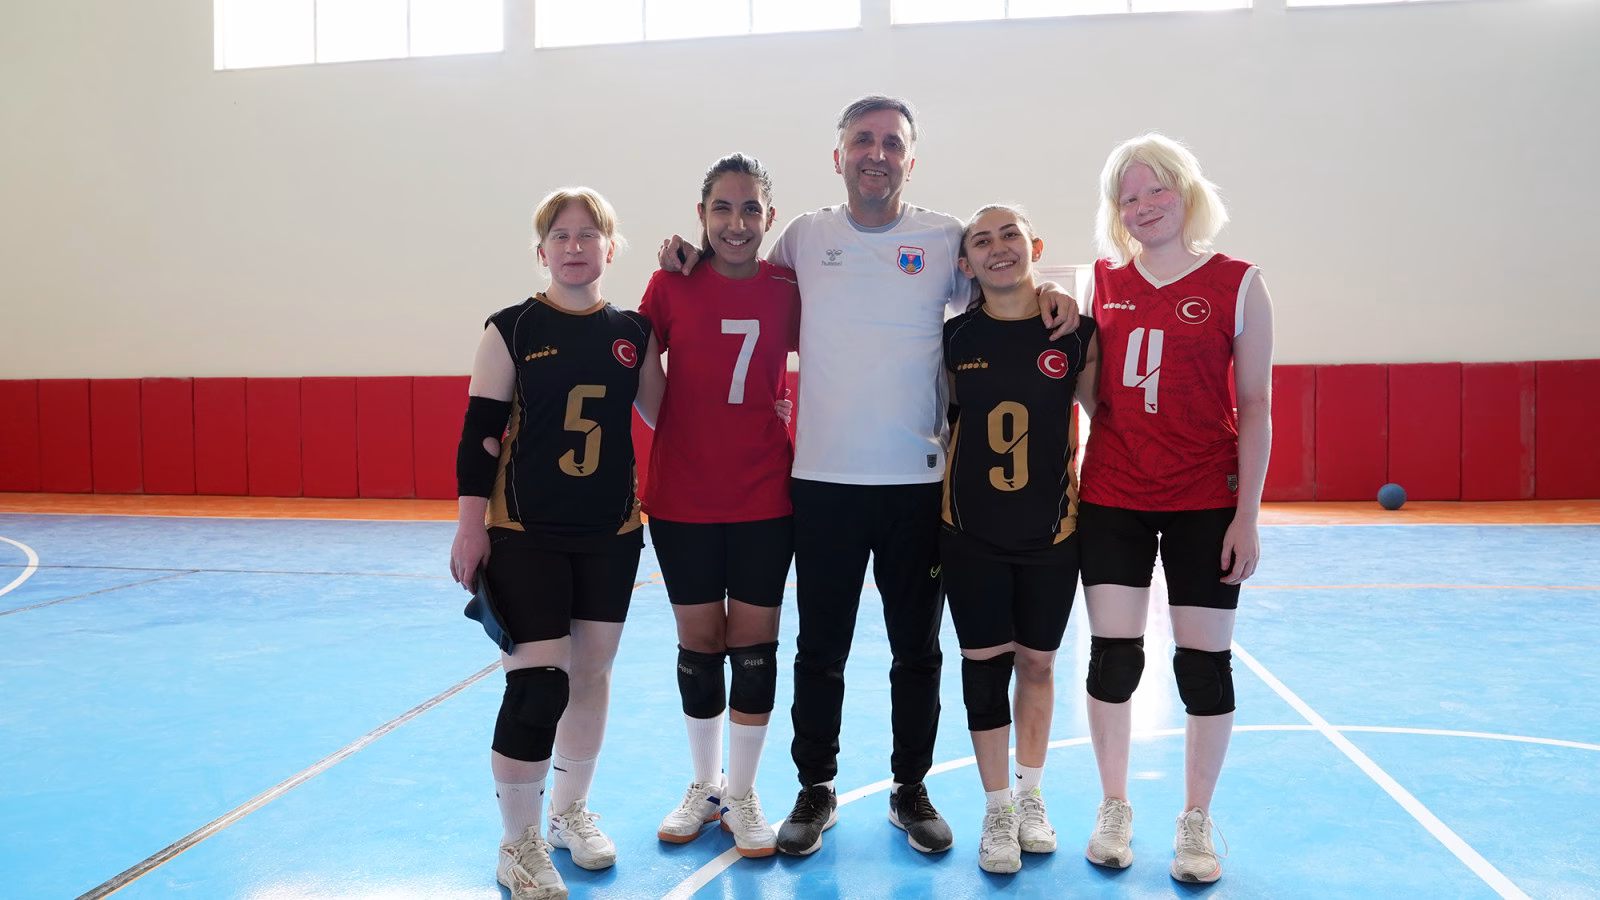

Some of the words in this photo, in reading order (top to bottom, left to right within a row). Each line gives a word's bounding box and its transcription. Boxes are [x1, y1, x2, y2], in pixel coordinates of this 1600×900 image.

[525, 346, 558, 361] dadoa
[721, 319, 760, 404] 7
[957, 357, 988, 370] dadoa
[1122, 327, 1164, 414] 4
[559, 384, 607, 476] 5
[987, 401, 1029, 491] 9
